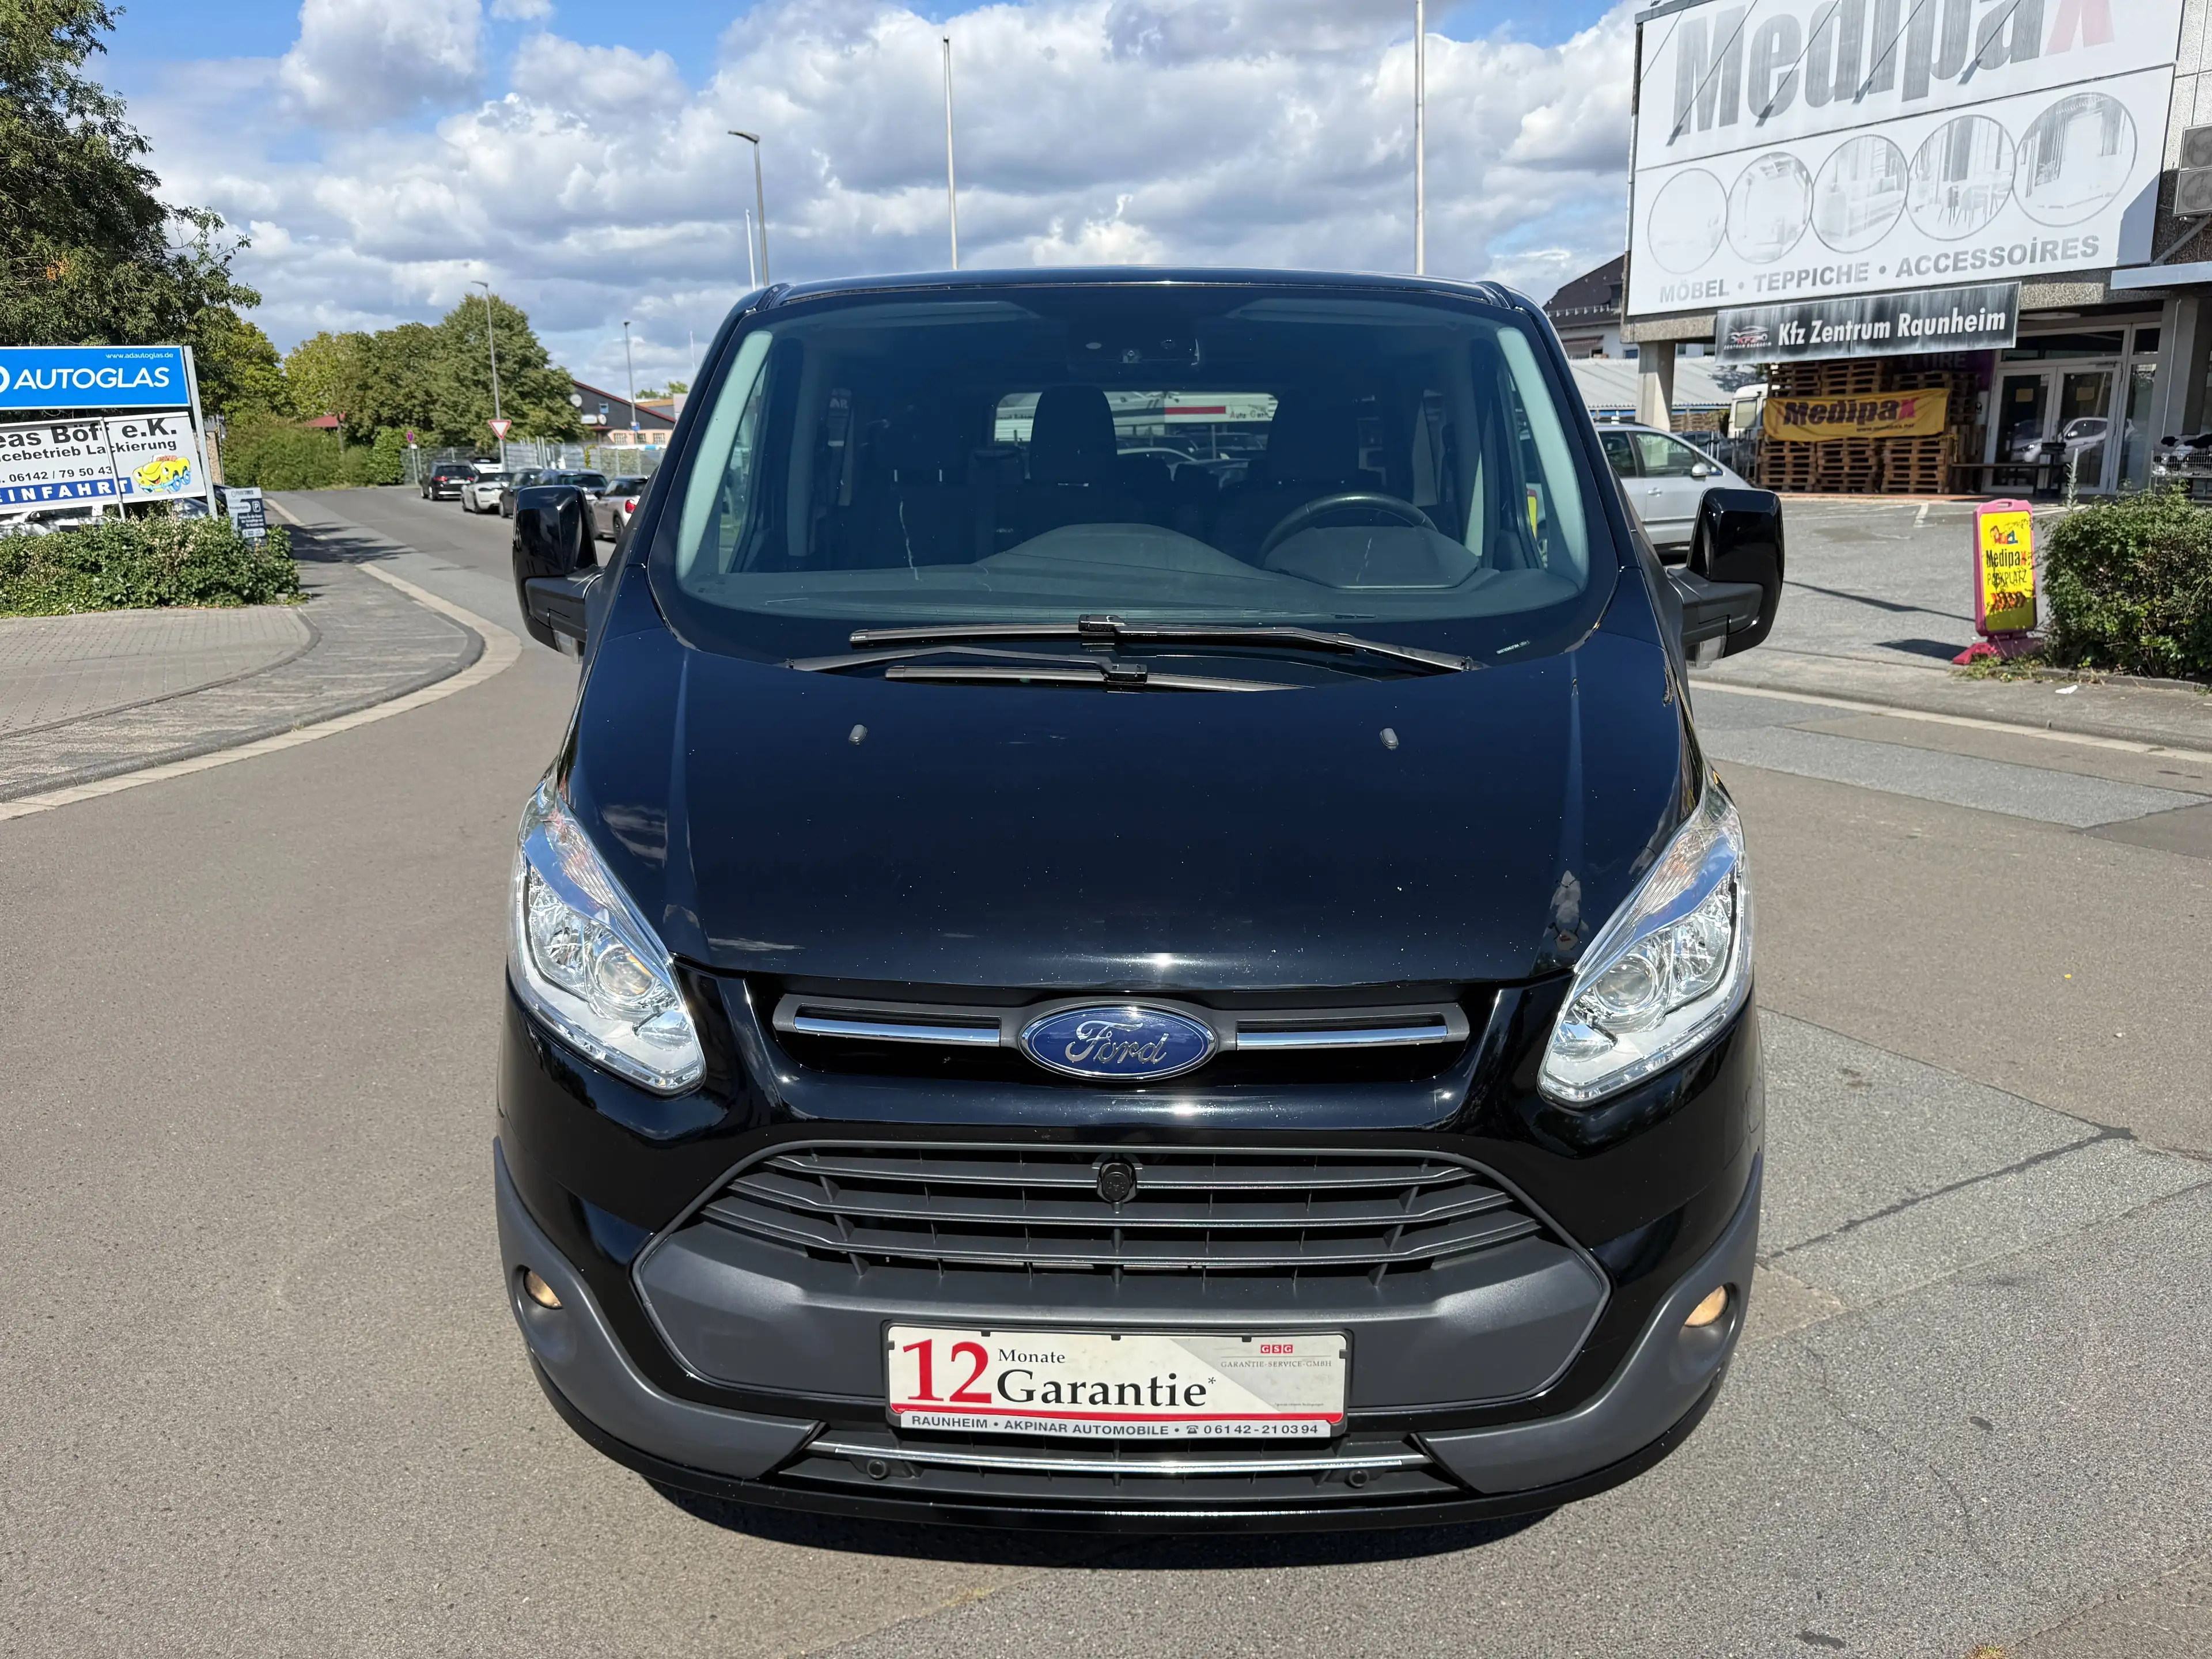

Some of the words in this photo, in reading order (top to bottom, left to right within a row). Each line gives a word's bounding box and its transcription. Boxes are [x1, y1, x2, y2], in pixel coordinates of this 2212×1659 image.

[1660, 279, 1729, 303] MÖBEL
[1753, 262, 1869, 293] TEPPICHE
[1778, 320, 1806, 346] Kfz
[1810, 318, 1890, 344] Zentrum
[1897, 307, 2006, 338] Raunheim
[13, 367, 170, 390] AUTOGLAS
[1783, 397, 1919, 425] Medipax
[122, 418, 177, 438] e.K.
[0, 446, 81, 461] cebetrieb
[9, 471, 48, 482] 06142
[59, 469, 74, 478] 79
[79, 467, 94, 476] 50
[98, 466, 113, 475] 43
[0, 480, 127, 502] INFAHRT
[1065, 1020, 1169, 1064] Ford
[1260, 1344, 1293, 1354] GSG
[903, 1338, 992, 1404] 12
[998, 1348, 1065, 1363] Monate
[911, 1415, 988, 1429] RAUNHEIM
[1004, 1420, 1068, 1433] AKPINAR
[1072, 1424, 1169, 1435] AUTOMOBILE
